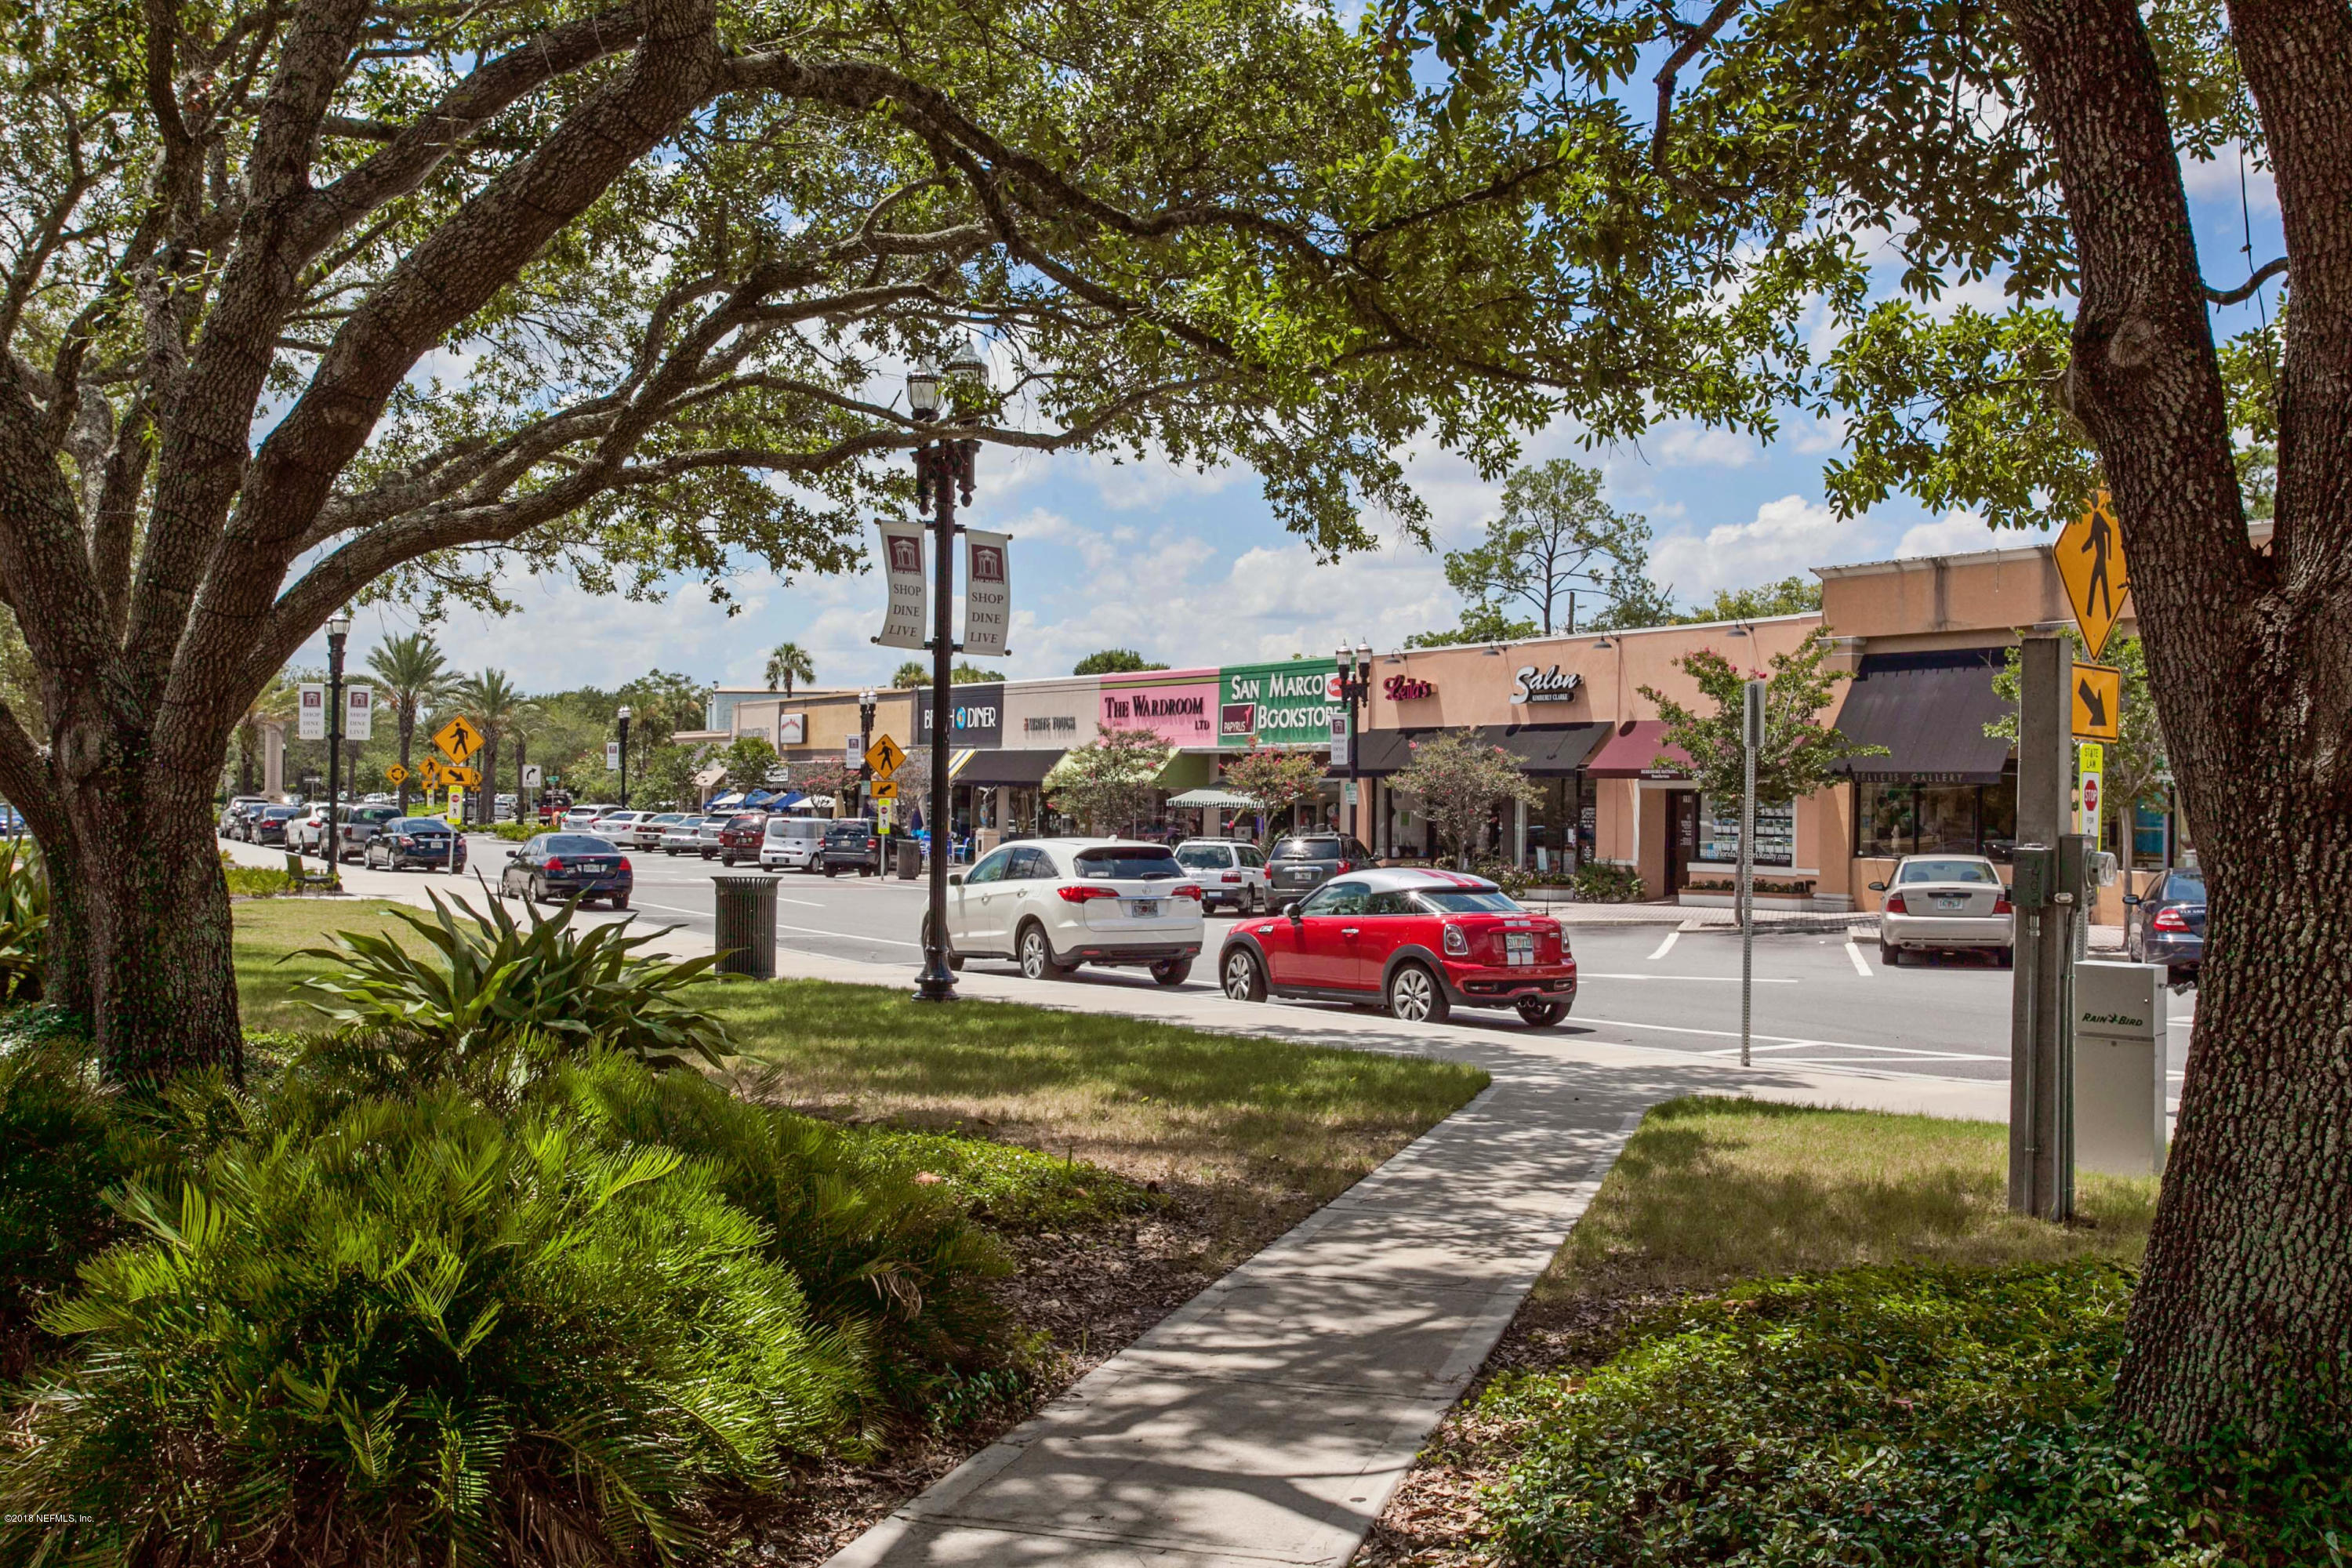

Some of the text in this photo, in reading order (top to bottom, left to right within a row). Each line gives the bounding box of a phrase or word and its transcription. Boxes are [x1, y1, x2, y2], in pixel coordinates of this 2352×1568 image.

[893, 583, 921, 597] SHOP
[971, 592, 1004, 604] SHOP
[893, 604, 920, 617] DINE
[972, 612, 1001, 624] DINE
[888, 624, 917, 637] LIVE
[970, 632, 998, 644] LIVE
[1231, 675, 1261, 700] SAN
[1269, 673, 1324, 698] MARCO
[1508, 665, 1577, 704] Salon
[1105, 695, 1203, 718] THE WARDROOM
[967, 706, 996, 728] DINER
[1195, 720, 1210, 730] LTD
[1224, 721, 1246, 732] PAPYRUS
[2085, 748, 2099, 758] STATE
[1911, 773, 1963, 782] GALLERY
[2085, 789, 2098, 801] STOP
[2082, 1013, 2143, 1026] RAIN BIRD
